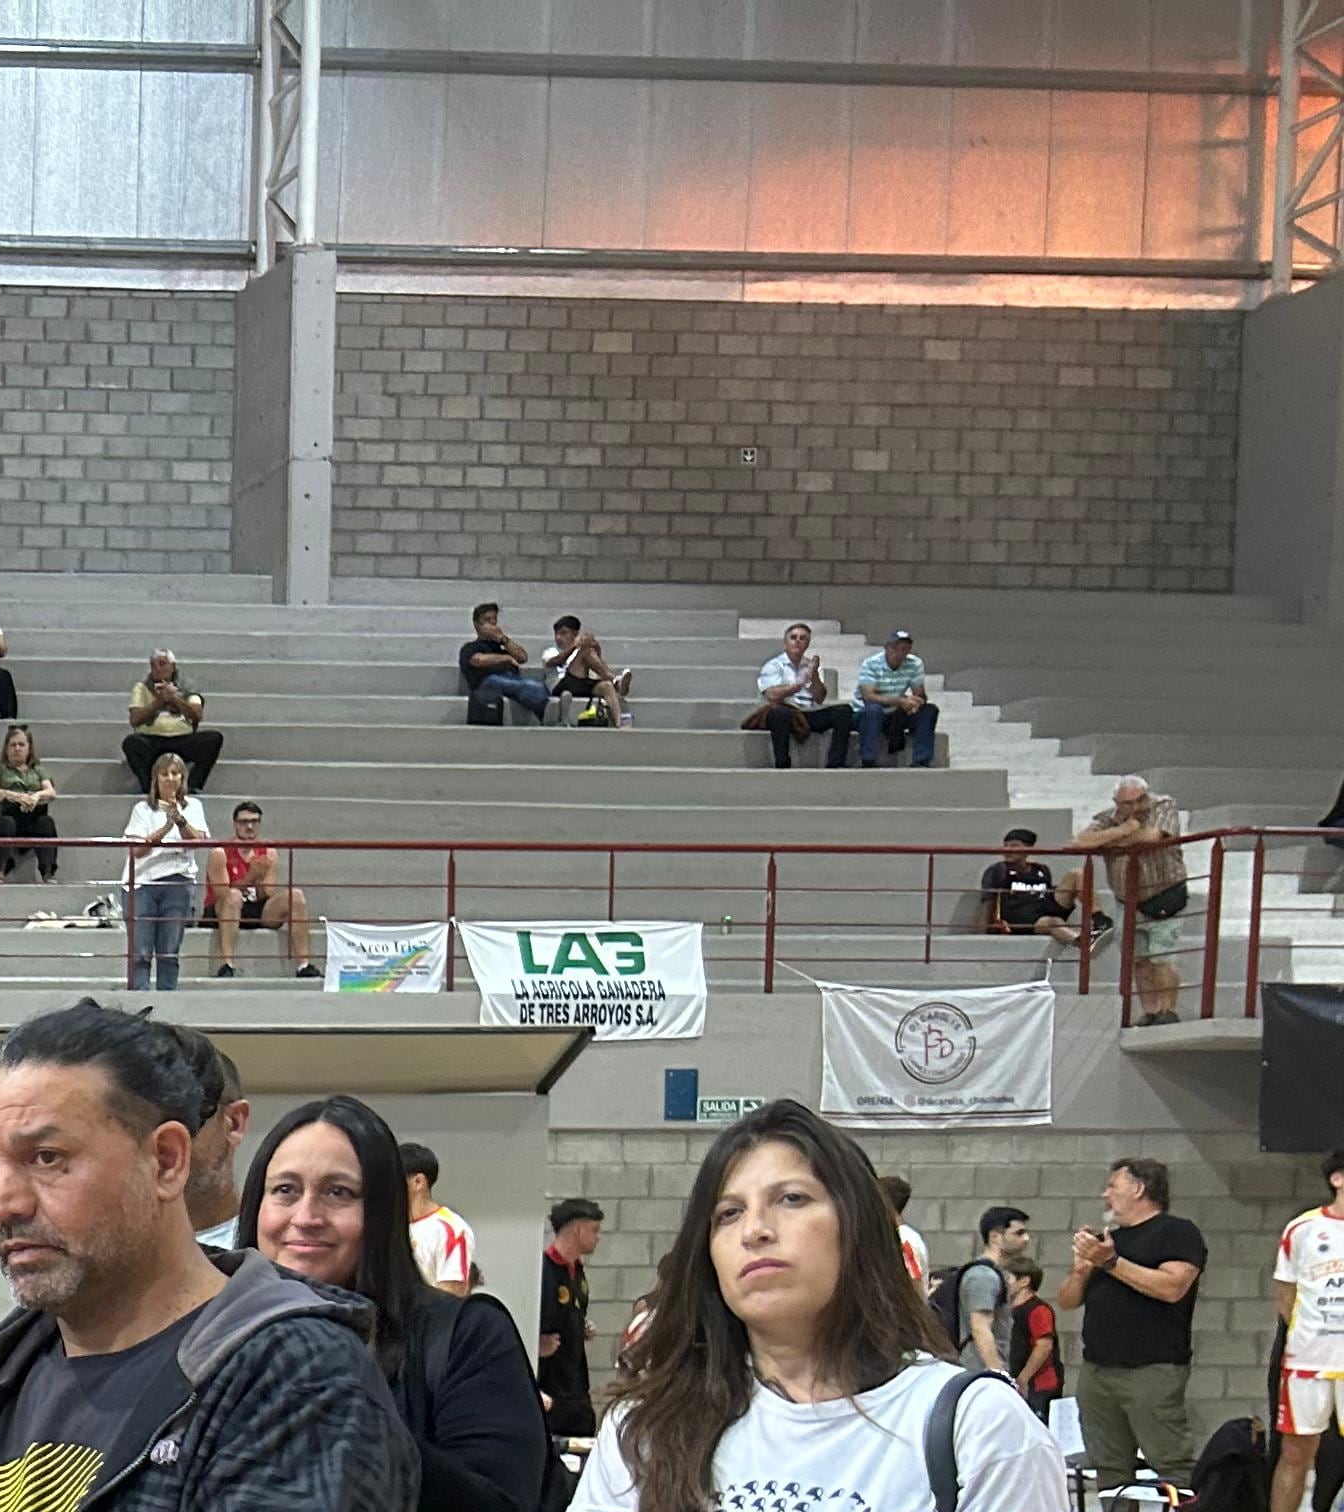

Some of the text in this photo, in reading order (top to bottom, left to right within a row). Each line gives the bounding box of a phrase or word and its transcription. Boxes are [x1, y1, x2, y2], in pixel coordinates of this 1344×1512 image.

[516, 931, 646, 976] LAG
[511, 979, 666, 1001] LA AGRICOLA GANADERA
[520, 1003, 535, 1025] DE
[539, 1003, 570, 1025] TRES
[574, 1003, 631, 1026] ARROYOS
[702, 1101, 737, 1112] SALIDA
